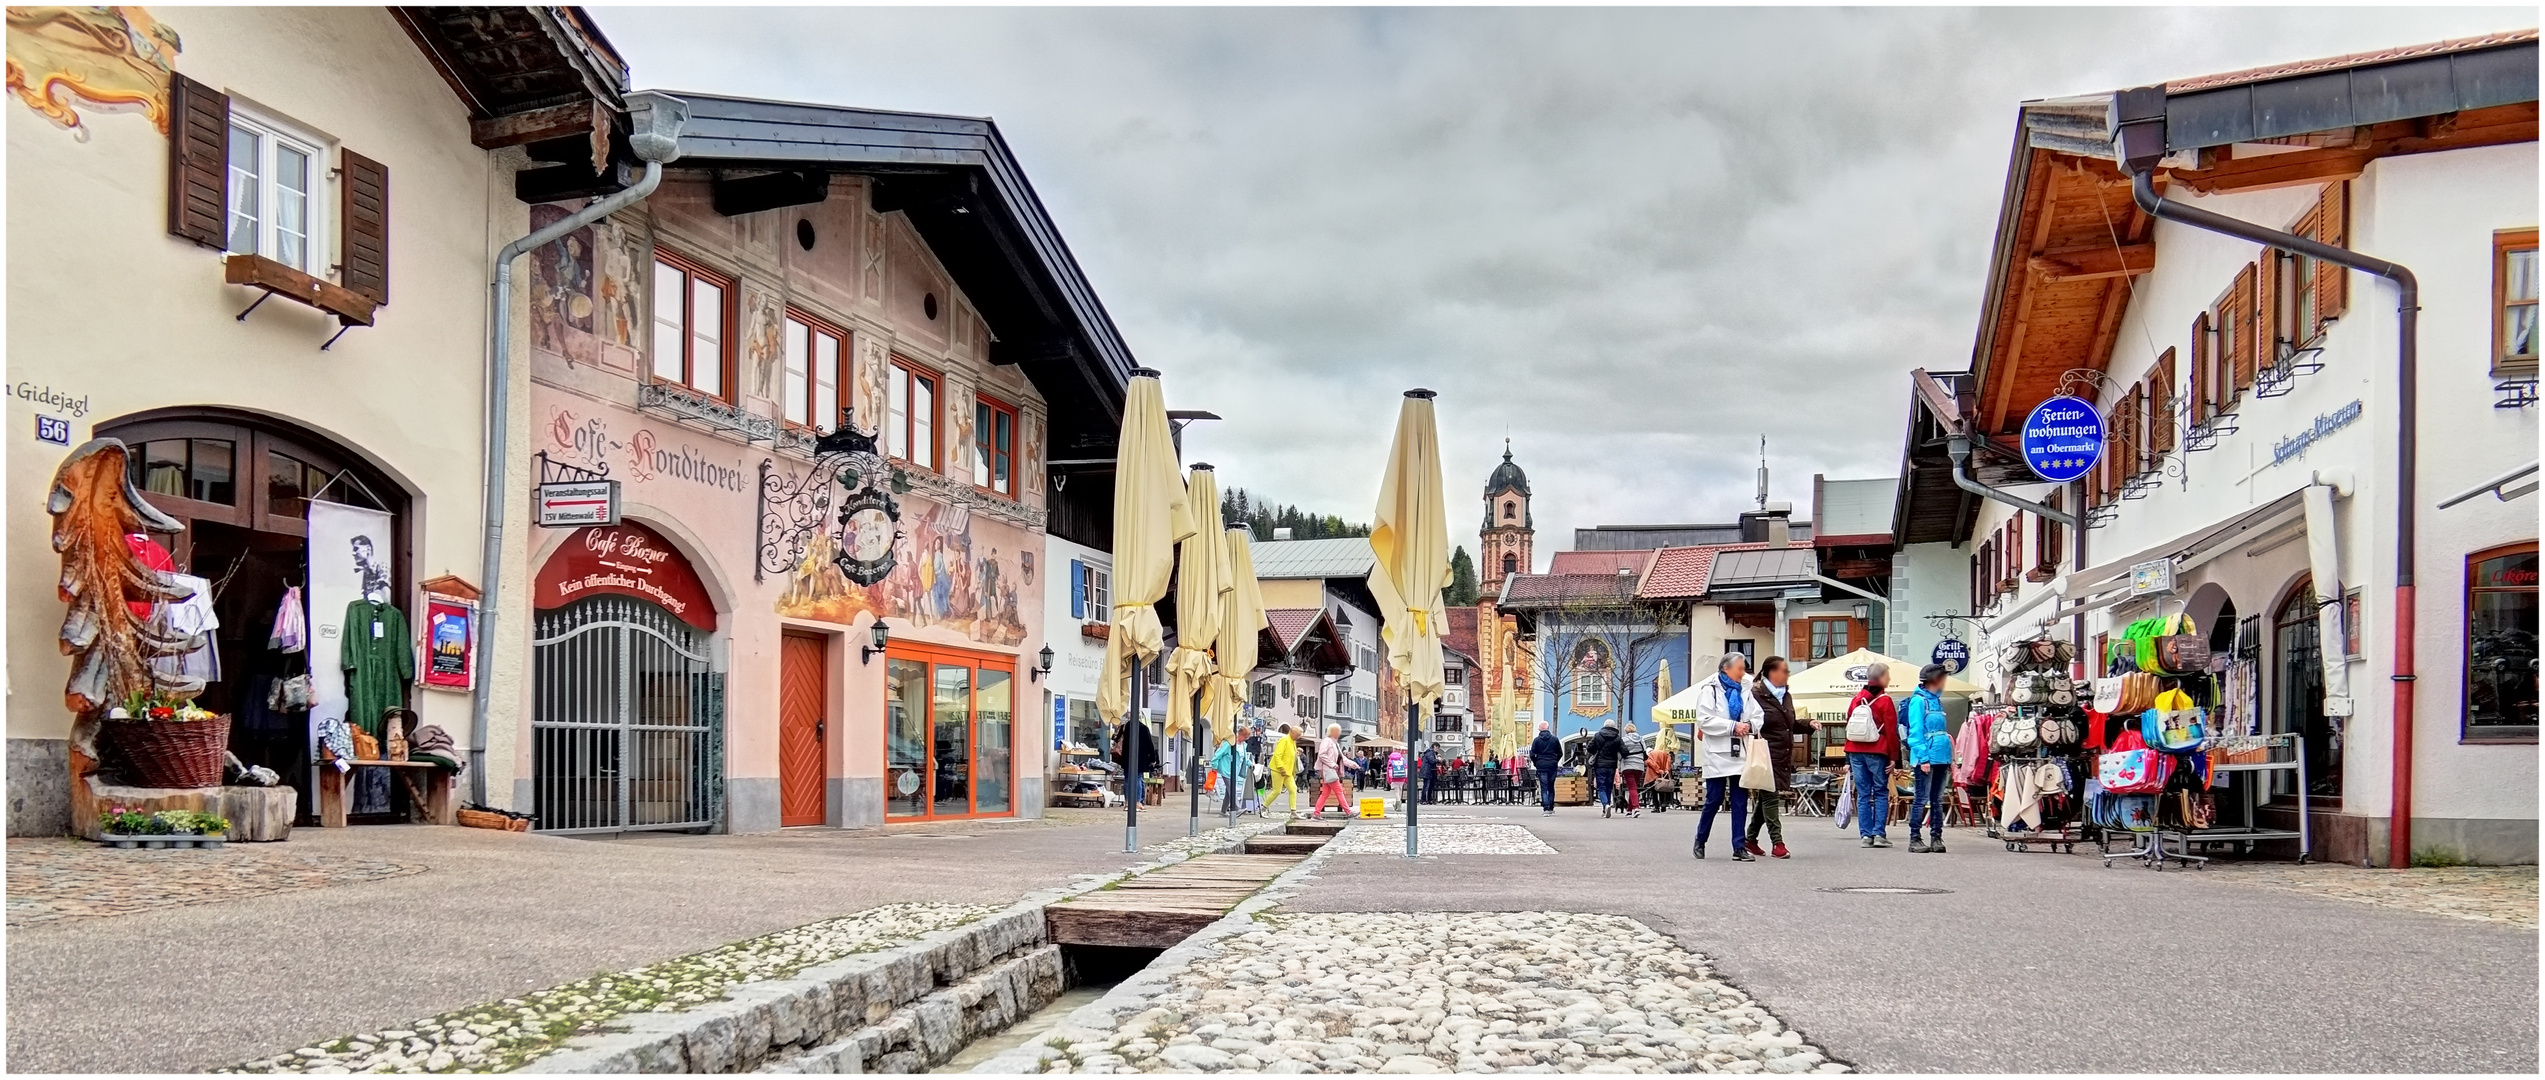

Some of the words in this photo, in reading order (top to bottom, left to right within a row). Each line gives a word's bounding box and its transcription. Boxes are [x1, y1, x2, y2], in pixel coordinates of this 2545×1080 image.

[16, 381, 89, 418] Gidejagl
[41, 418, 67, 441] 56
[2028, 425, 2097, 439] wohnungen
[2047, 442, 2094, 453] Obermarkt
[544, 486, 607, 497] Veranstaltungssaal
[545, 513, 557, 521] TSV
[558, 511, 594, 521] Mittenwald
[585, 527, 618, 558] Café
[620, 535, 669, 564] Bozner
[2491, 568, 2538, 585] Liköre
[558, 579, 583, 596] Kein
[584, 573, 636, 588] öffentlicher
[637, 577, 686, 613] Durchgang!
[1938, 642, 1964, 651] Grill-
[1068, 652, 1099, 670] Reisebüro
[1672, 709, 1697, 720] BRAU
[1816, 712, 1846, 721] MITTEN
